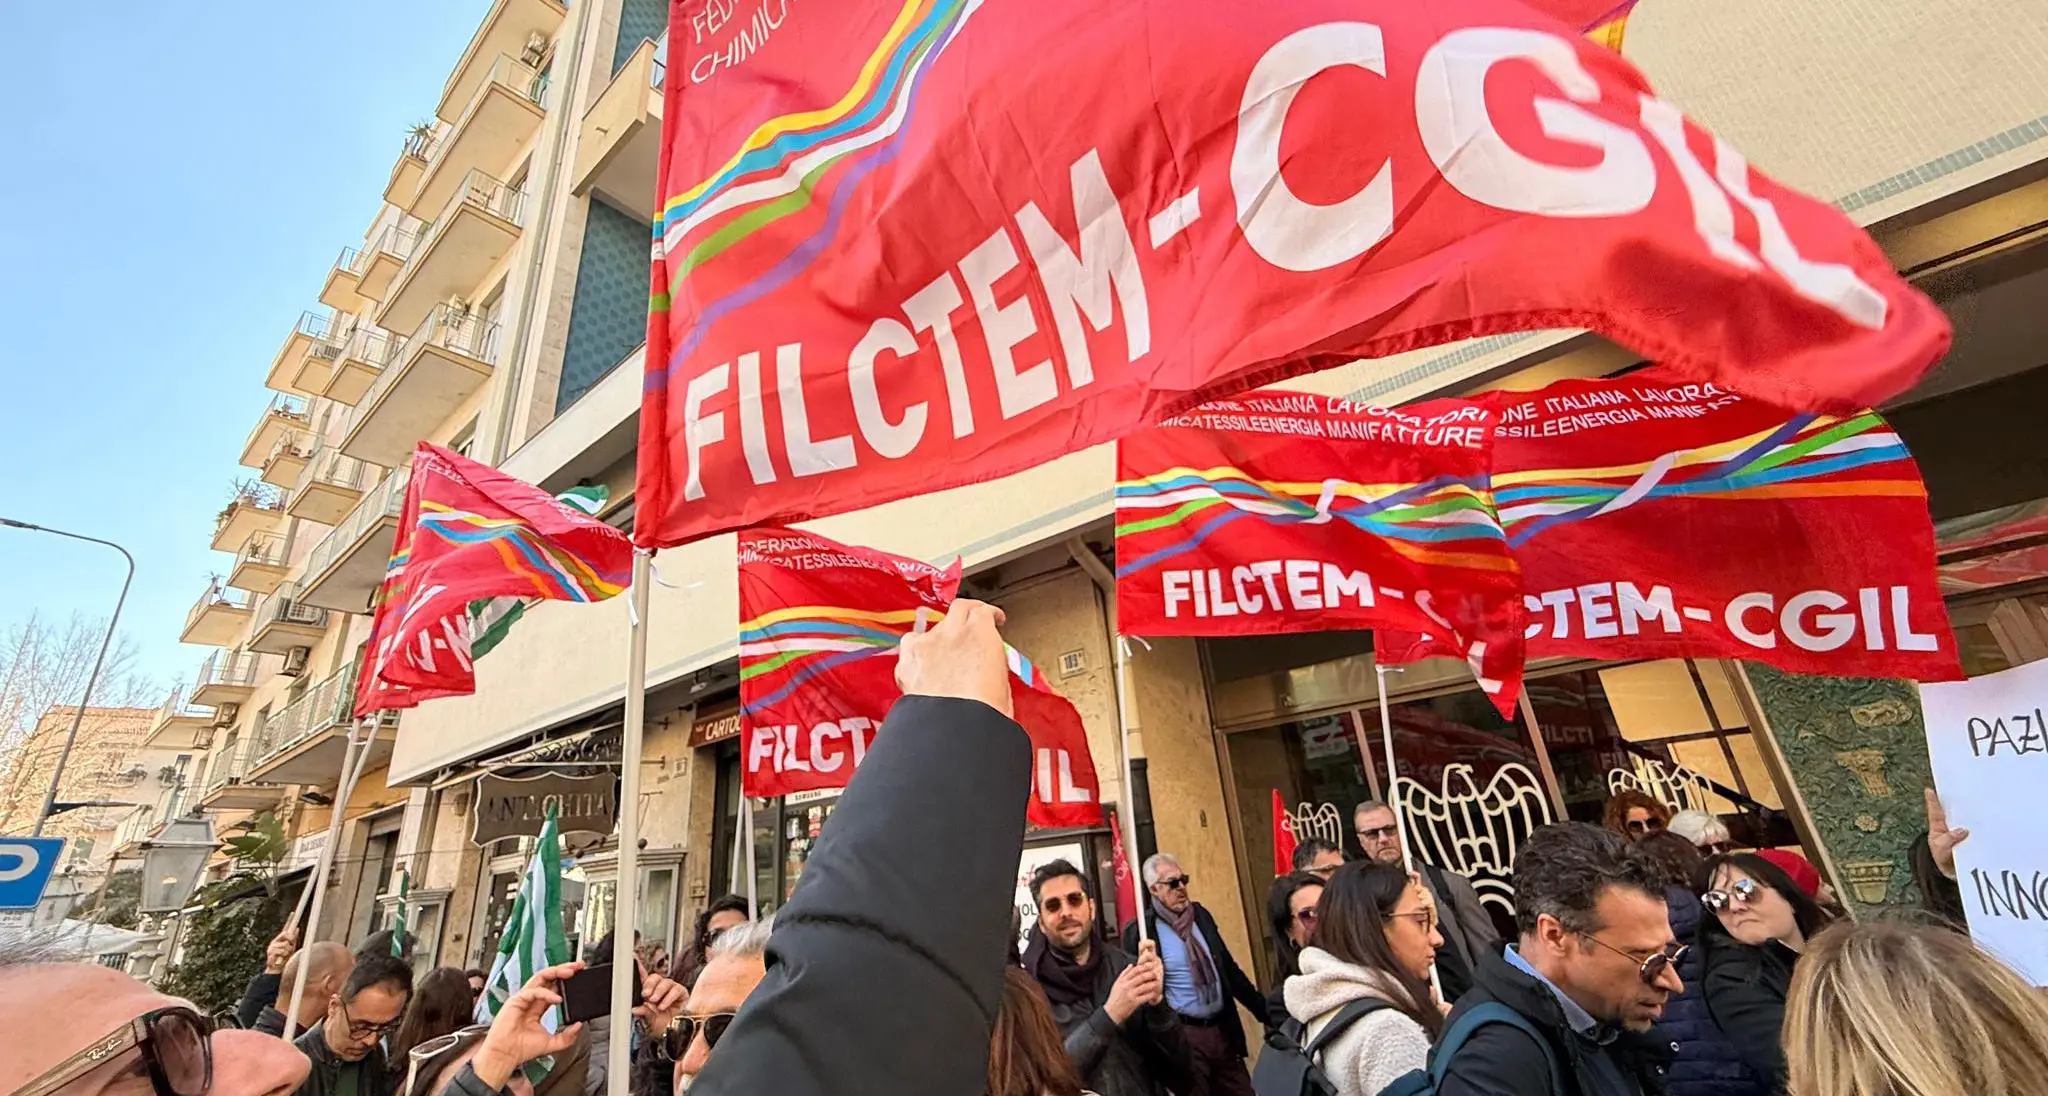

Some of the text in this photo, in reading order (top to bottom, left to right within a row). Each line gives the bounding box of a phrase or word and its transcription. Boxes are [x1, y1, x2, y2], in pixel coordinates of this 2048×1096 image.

[692, 0, 739, 45] FED
[690, 0, 797, 84] CHIMIC
[1246, 395, 1319, 414] ITALIANA
[1327, 397, 1489, 428] LAVORATORI
[1545, 389, 1631, 414] ITALIANA
[1325, 420, 1485, 449] MANIFATTURE
[1494, 407, 1651, 438] SSILEENERGIA
[1523, 581, 1939, 653] CTEM-CGIL
[704, 714, 741, 741] CARTOL
